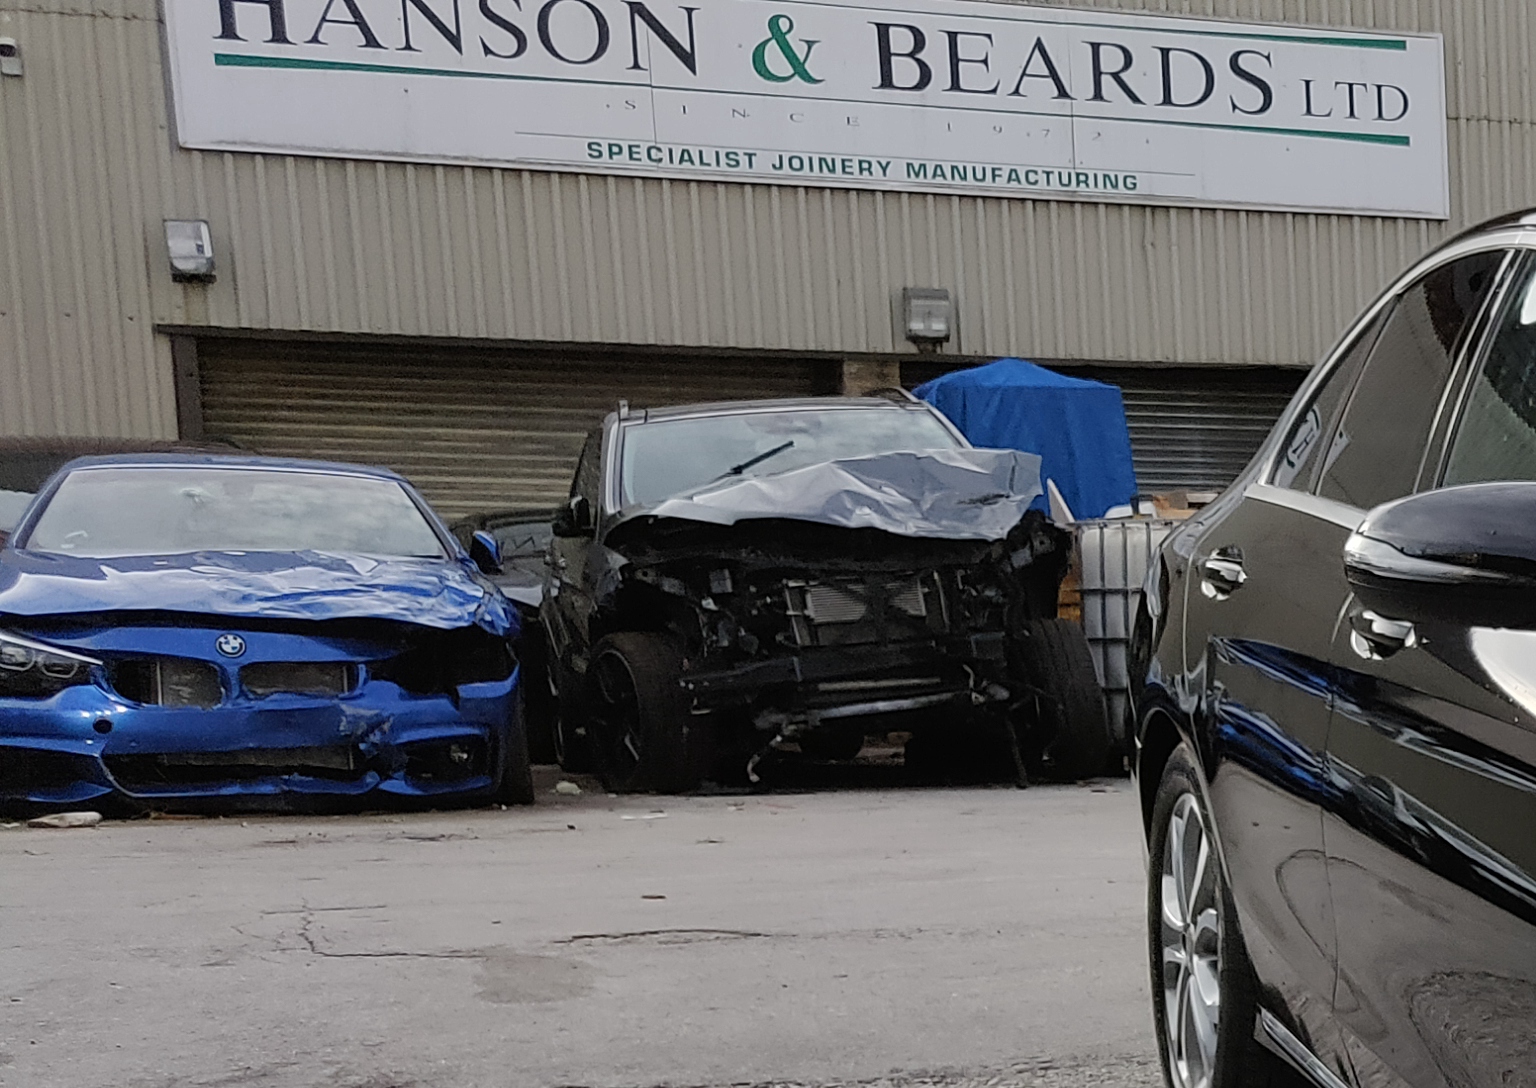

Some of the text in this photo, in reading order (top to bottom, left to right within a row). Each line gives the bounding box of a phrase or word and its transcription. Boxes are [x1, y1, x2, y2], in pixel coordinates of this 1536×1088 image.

[213, 0, 1409, 122] HANSON & BEARDS LTD
[587, 141, 1139, 191] SPECIALIST JOINERY MANUFACTURING
